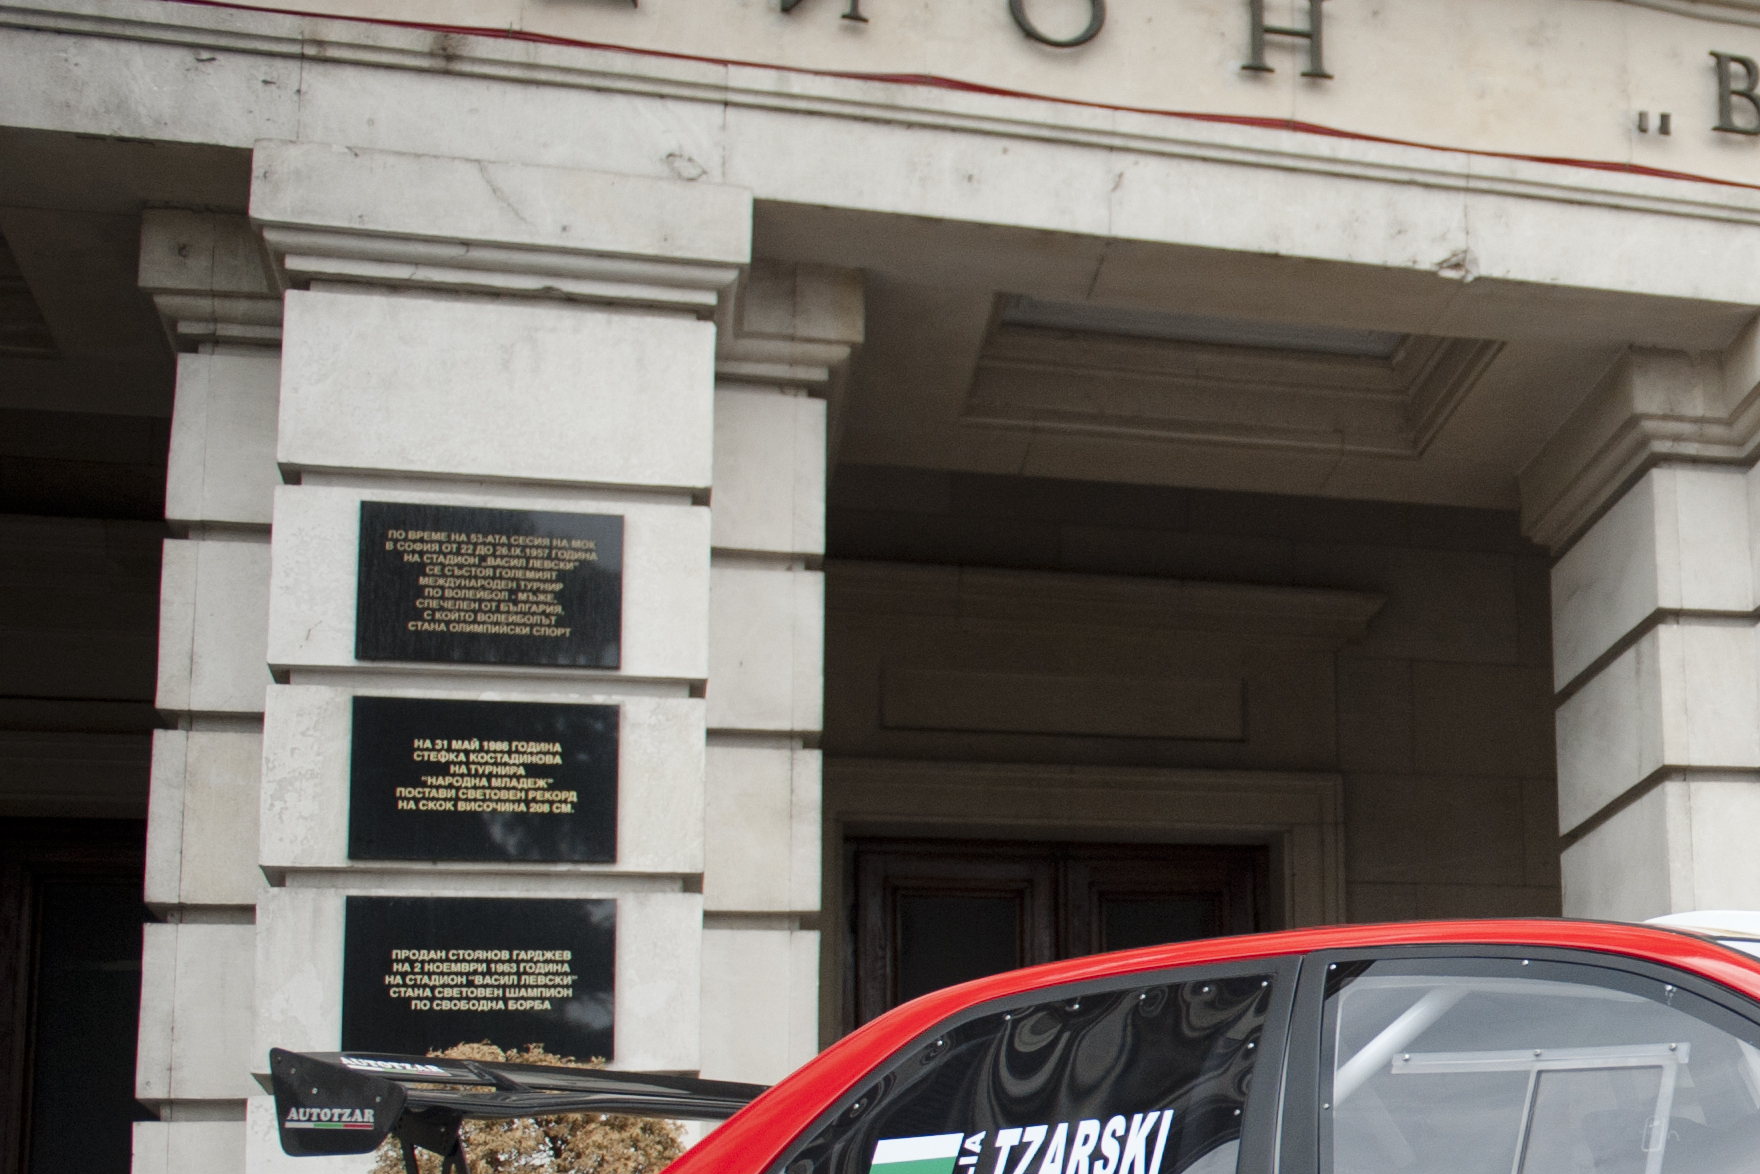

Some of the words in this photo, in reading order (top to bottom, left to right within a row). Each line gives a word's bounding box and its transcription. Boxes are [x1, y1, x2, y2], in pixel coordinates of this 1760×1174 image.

[388, 530, 405, 539] ПО
[408, 531, 448, 541] ВРЕМЕ
[451, 532, 467, 542] НА
[470, 533, 508, 544] 53-АТА
[510, 535, 550, 545] СЕСИЯ
[552, 537, 568, 547] НА
[572, 538, 596, 549] МОК
[386, 542, 394, 550] В
[397, 542, 439, 552] СОФИЯ
[442, 543, 457, 553] ОТ
[460, 544, 473, 554] 22
[476, 545, 493, 555] ДО
[552, 547, 598, 560] ГОДИНА
[404, 553, 420, 562] НА
[424, 554, 479, 565] СТАДИОН
[426, 566, 441, 575] СЕ
[444, 567, 493, 577] СЪСТОЯ
[496, 569, 558, 580] ГОЛЕМИЯТ
[419, 577, 516, 589] МЕЖДУНАРОДЕН
[519, 581, 563, 591] ТУРНИР
[425, 588, 441, 597] ПО
[444, 588, 508, 600] ВОЛЕЙБОЛ
[416, 599, 478, 610] СПЕЧЕЛЕН
[482, 601, 498, 611] ОТ
[424, 611, 432, 619] С
[435, 610, 474, 621] КОЙТО
[477, 613, 557, 625] ВОЛЕЙБОЛЪТ
[408, 622, 446, 631] СТАНА
[450, 623, 530, 635] ОЛИМПИЙСКИ
[533, 627, 571, 637] СПОРТ
[414, 739, 432, 750] НА
[435, 740, 447, 750] 31
[452, 738, 479, 750] МАЙ
[512, 741, 562, 753] ГОДИНА
[414, 751, 466, 763] СТЕФКА
[470, 753, 562, 765] КОСТАДИНОВА
[450, 765, 467, 774] НА
[470, 765, 525, 776] ТУРНИРА
[396, 787, 456, 798] ПОСТАВИ
[458, 789, 525, 800] СВЕТОВЕН
[528, 790, 577, 802] РЕКОРД
[398, 800, 416, 810] НА
[419, 800, 455, 811] СКОК
[457, 802, 527, 812] ВИСОЧИНА
[552, 803, 574, 813] СМ.
[392, 950, 446, 960] ПРОДАН
[448, 950, 509, 960] СТОЯНОВ
[513, 950, 572, 962] ГАРДЖЕВ
[393, 962, 411, 972] НА
[414, 963, 421, 972] 2
[424, 963, 487, 973] НОЕМВРИ
[490, 963, 517, 973] 1963
[520, 963, 570, 974] ГОДИНА
[385, 975, 403, 985] НА
[406, 975, 467, 986] СТАДИОН
[390, 988, 432, 998] СТАНА
[435, 988, 503, 998] СВЕТОВЕН
[505, 988, 572, 998] ШАМПИОН
[411, 1000, 430, 1010] ПО
[432, 1000, 505, 1011] СВОБОДНА
[508, 1000, 551, 1010] БОРБА
[340, 1057, 445, 1073] AUTOTZAR
[287, 1107, 375, 1123] AUTOTZAR
